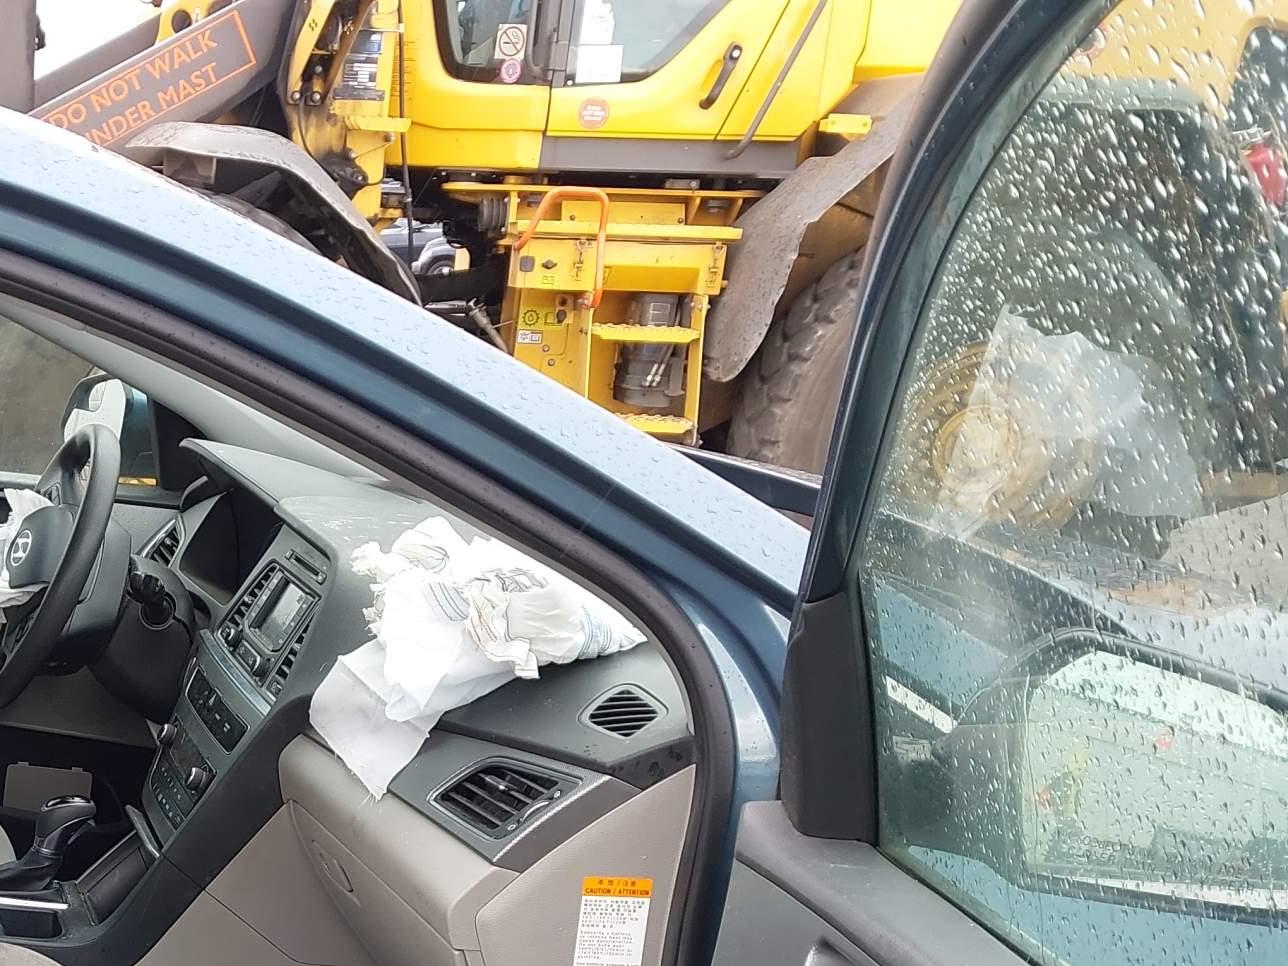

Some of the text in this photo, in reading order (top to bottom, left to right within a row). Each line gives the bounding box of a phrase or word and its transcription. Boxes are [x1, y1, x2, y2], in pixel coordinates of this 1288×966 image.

[50, 29, 217, 128] DO NOT WALK
[158, 62, 217, 111] MAST
[585, 887, 611, 895] CAUTION
[618, 888, 650, 896] ATTENTION
